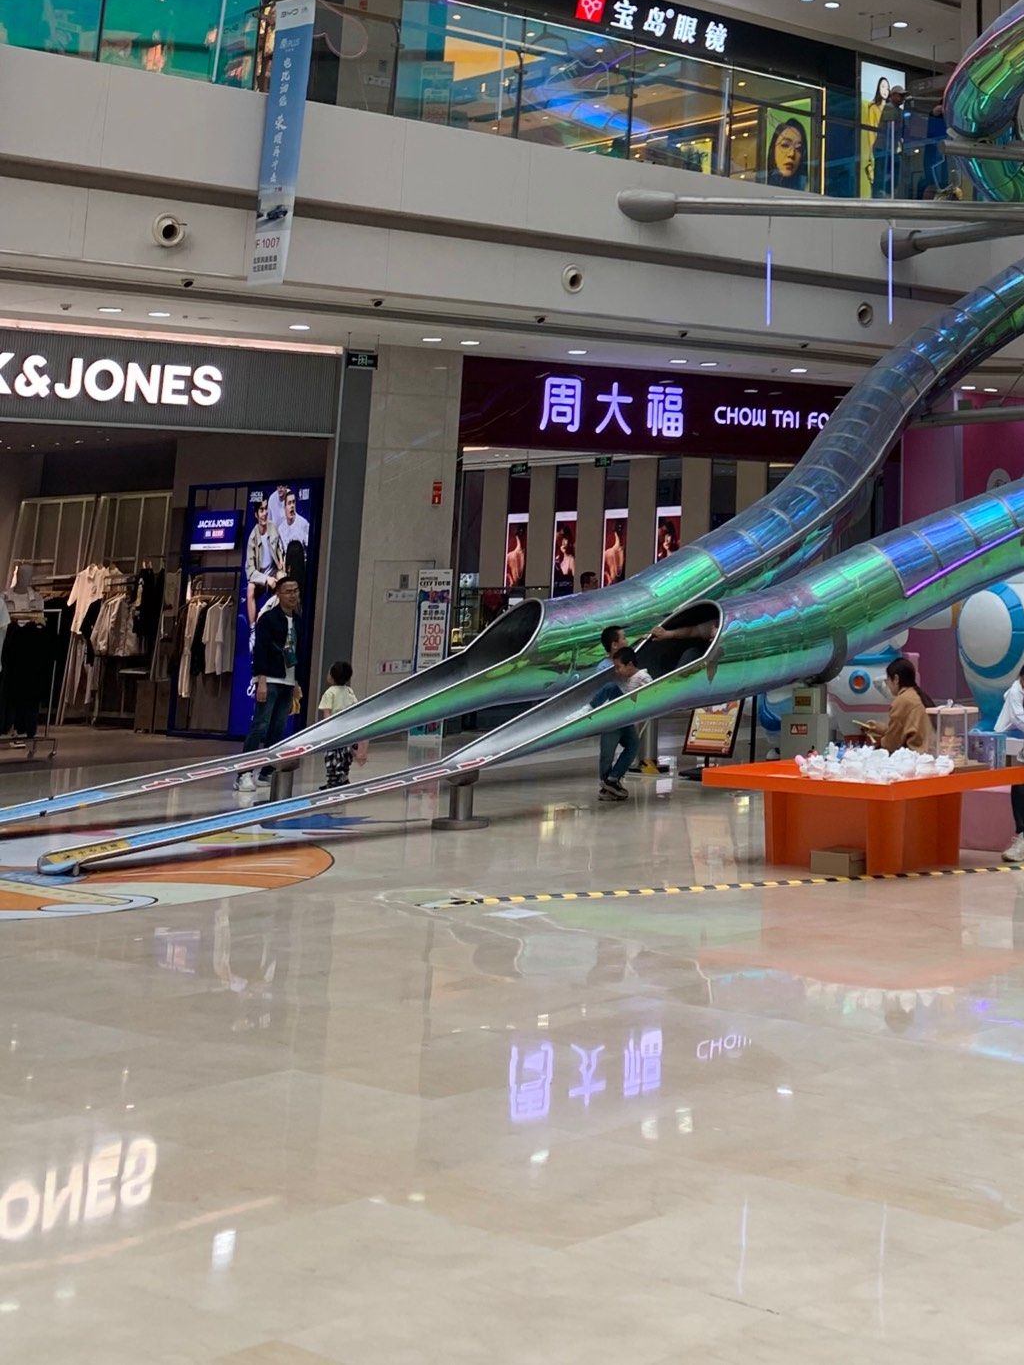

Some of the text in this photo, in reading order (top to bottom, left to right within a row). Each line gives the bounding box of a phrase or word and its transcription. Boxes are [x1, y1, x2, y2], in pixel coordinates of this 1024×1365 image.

[262, 237, 280, 248] 1007
[539, 377, 684, 438] 周大福
[714, 406, 767, 428] CHOW
[771, 409, 800, 429] TAI
